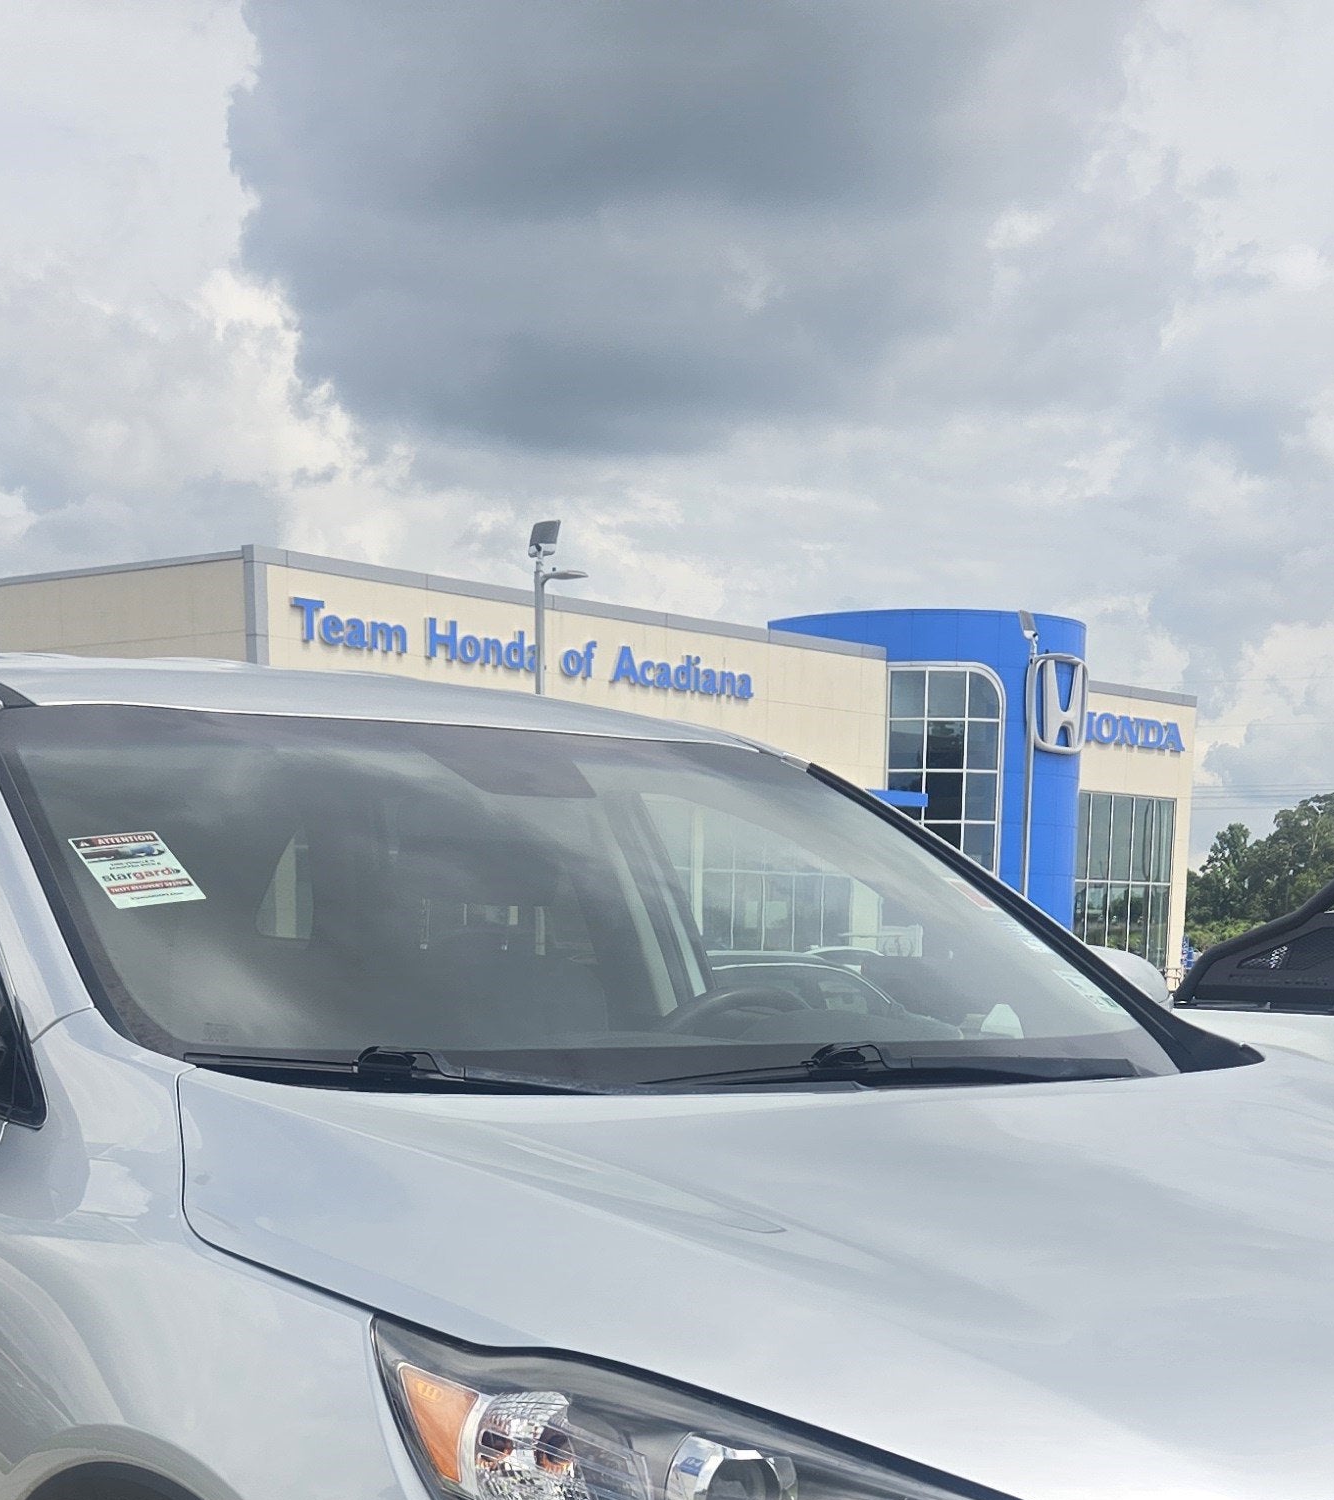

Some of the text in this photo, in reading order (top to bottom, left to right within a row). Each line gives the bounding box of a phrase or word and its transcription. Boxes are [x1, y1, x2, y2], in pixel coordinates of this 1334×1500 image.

[291, 597, 754, 699] Team Honda of Acadiana
[97, 834, 154, 845] ATTENTION
[101, 867, 172, 882] stargard
